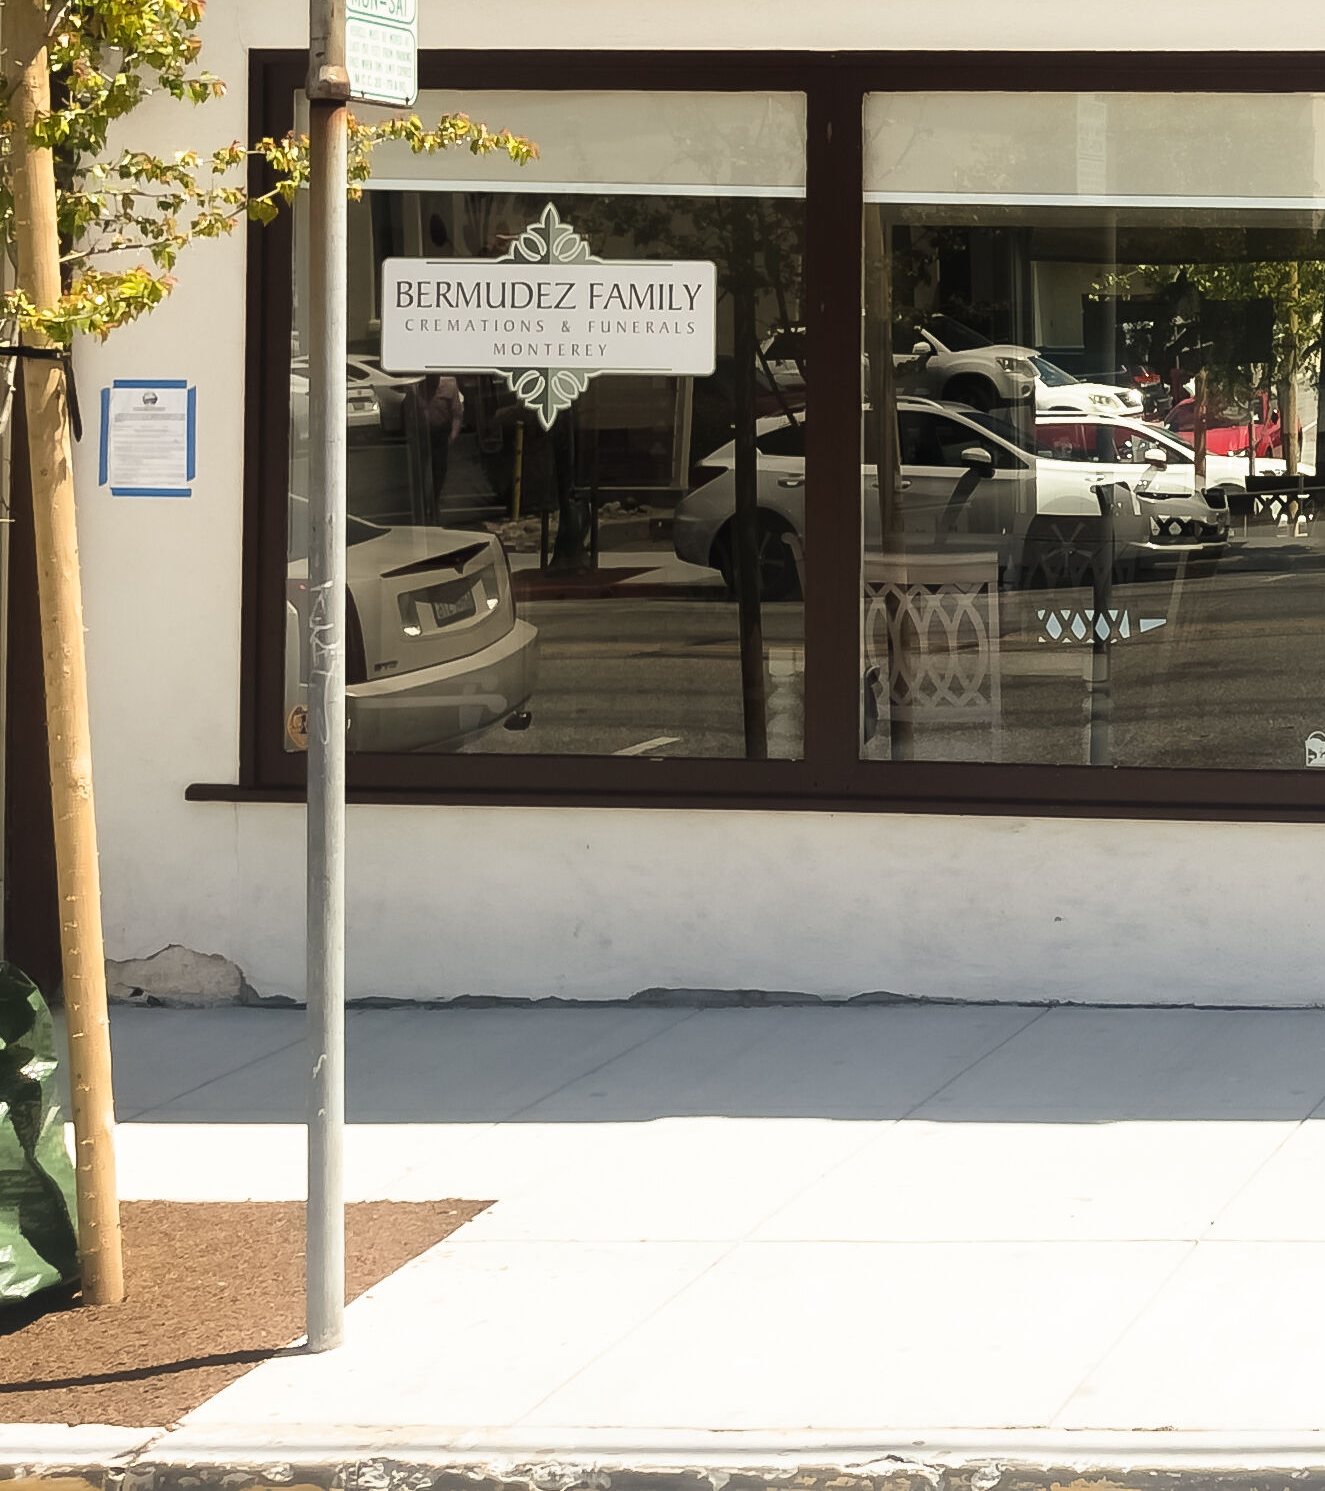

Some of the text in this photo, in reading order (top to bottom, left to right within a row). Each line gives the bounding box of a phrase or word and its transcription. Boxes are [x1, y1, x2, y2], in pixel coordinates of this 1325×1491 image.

[395, 280, 704, 311] BERMUDEZ FAMILY
[404, 318, 697, 335] CREMATIONS & FUNERALS
[493, 342, 608, 357] MONTEREY
